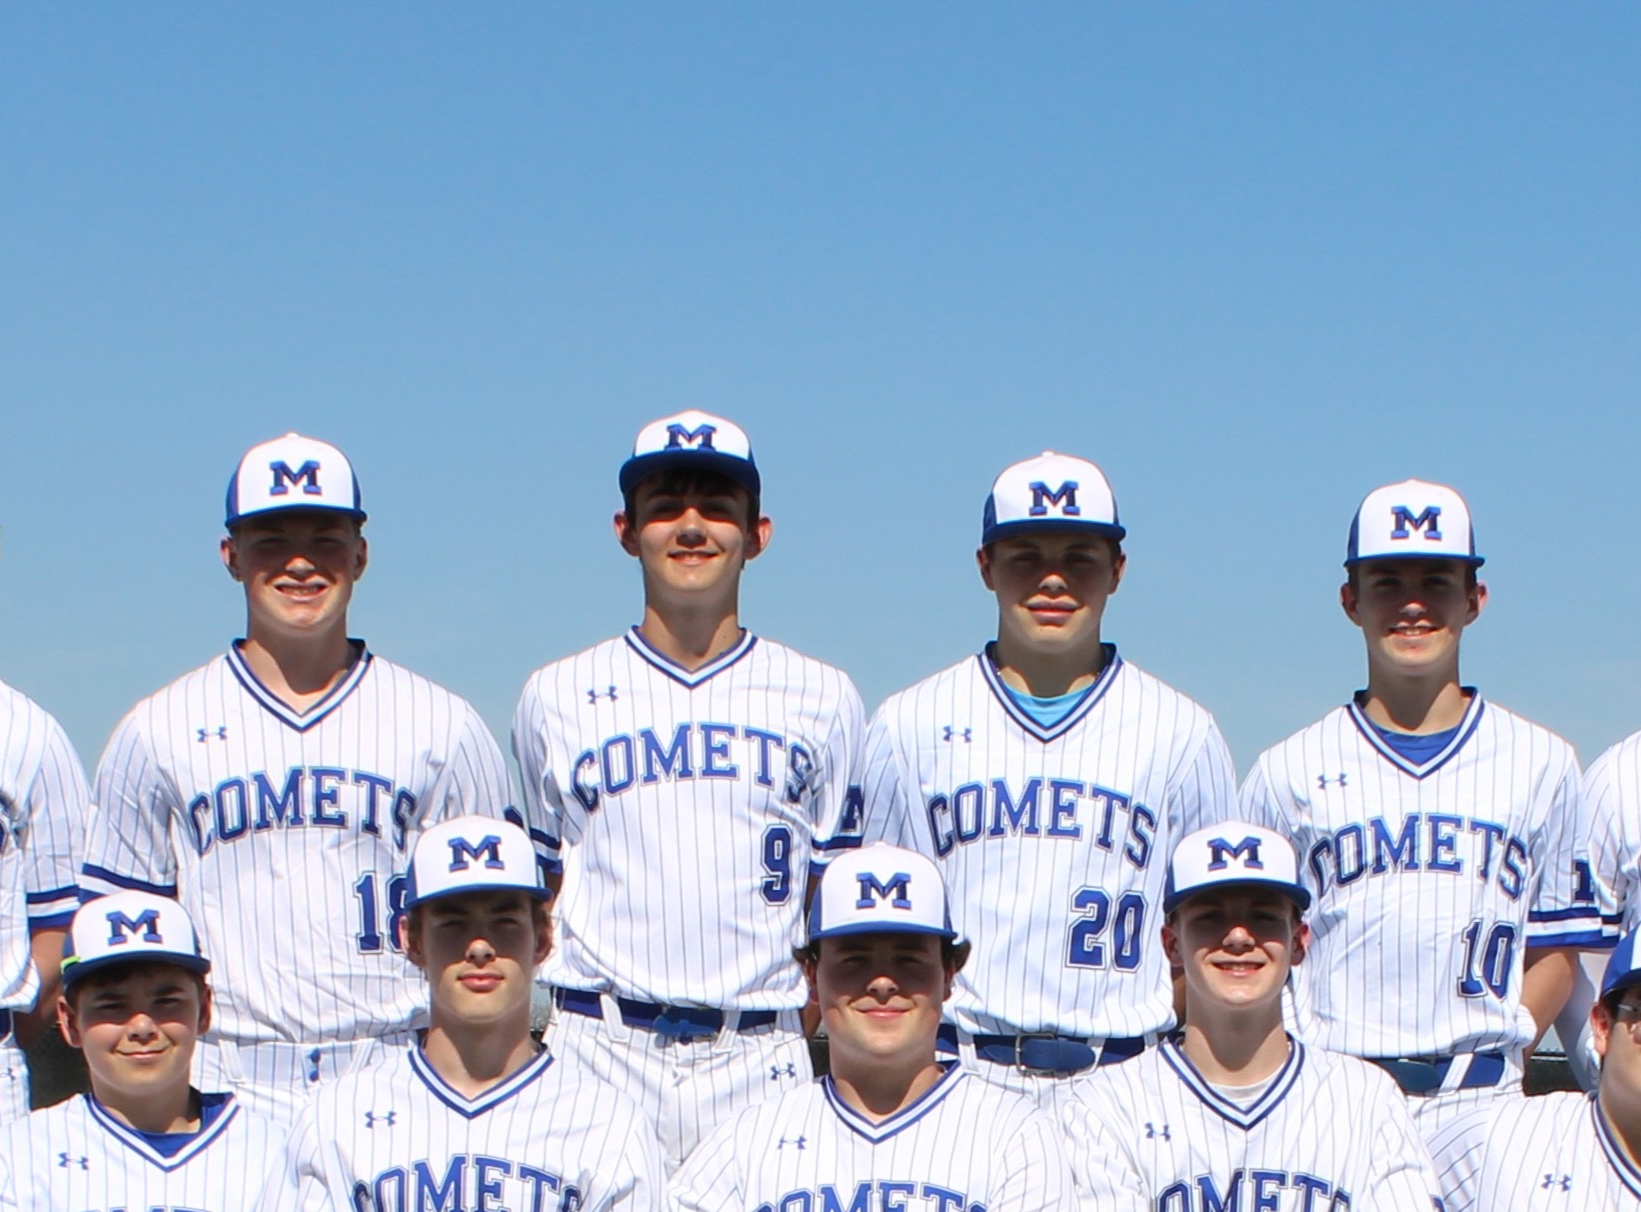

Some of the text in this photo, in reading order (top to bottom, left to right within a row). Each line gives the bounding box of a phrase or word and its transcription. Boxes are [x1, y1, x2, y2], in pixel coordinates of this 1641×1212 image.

[665, 424, 717, 451] M
[270, 460, 322, 495] M
[1028, 481, 1080, 516] M
[1390, 506, 1442, 540] M
[573, 722, 815, 814] COMETS
[190, 766, 417, 857] COMETS
[928, 777, 1158, 871] COMETS
[448, 835, 504, 871] M
[761, 824, 791, 906] 9
[1208, 837, 1262, 871] M
[1308, 813, 1527, 900] COMETS
[856, 872, 913, 910] M
[106, 909, 161, 945] M
[1067, 885, 1147, 971] 20
[1458, 921, 1516, 999] 10
